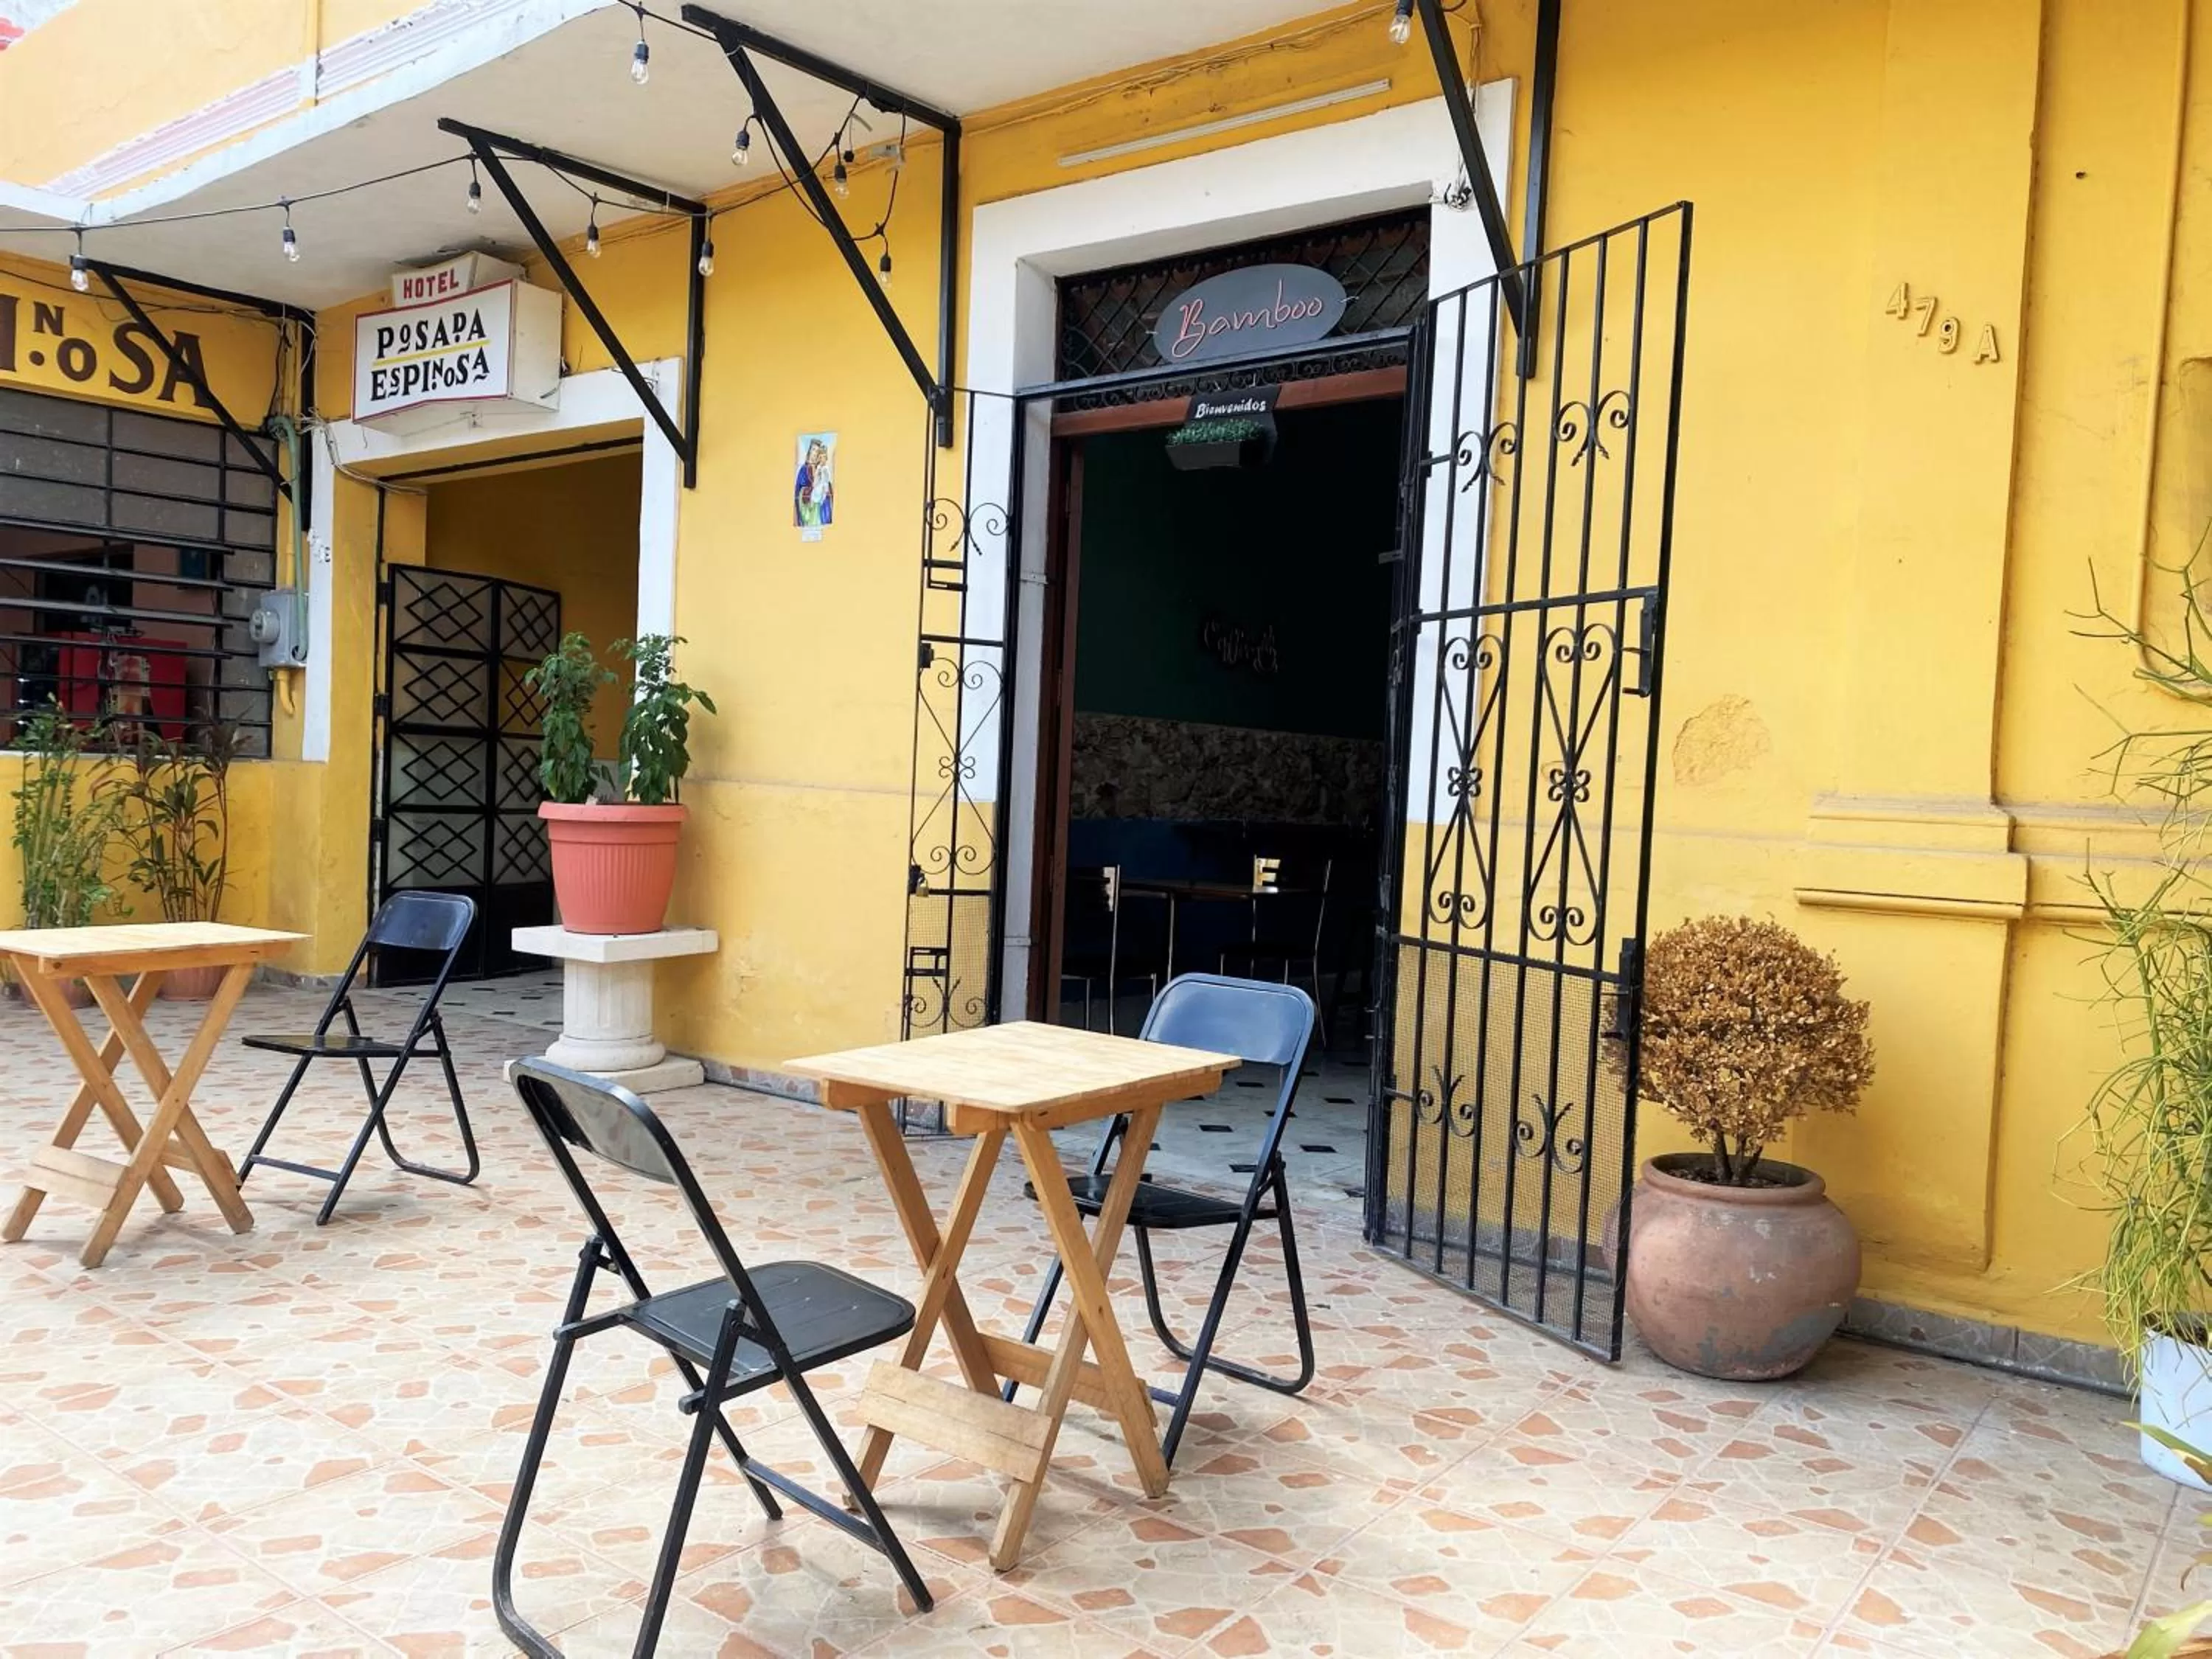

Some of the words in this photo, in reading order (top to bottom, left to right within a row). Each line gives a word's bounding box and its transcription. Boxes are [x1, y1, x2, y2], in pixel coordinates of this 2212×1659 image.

[403, 268, 459, 299] HOTEL
[377, 307, 487, 359] POSADA
[1172, 278, 1324, 358] Bamboo
[371, 346, 490, 401] ESPINOSA
[1195, 398, 1267, 419] Bienvenidos
